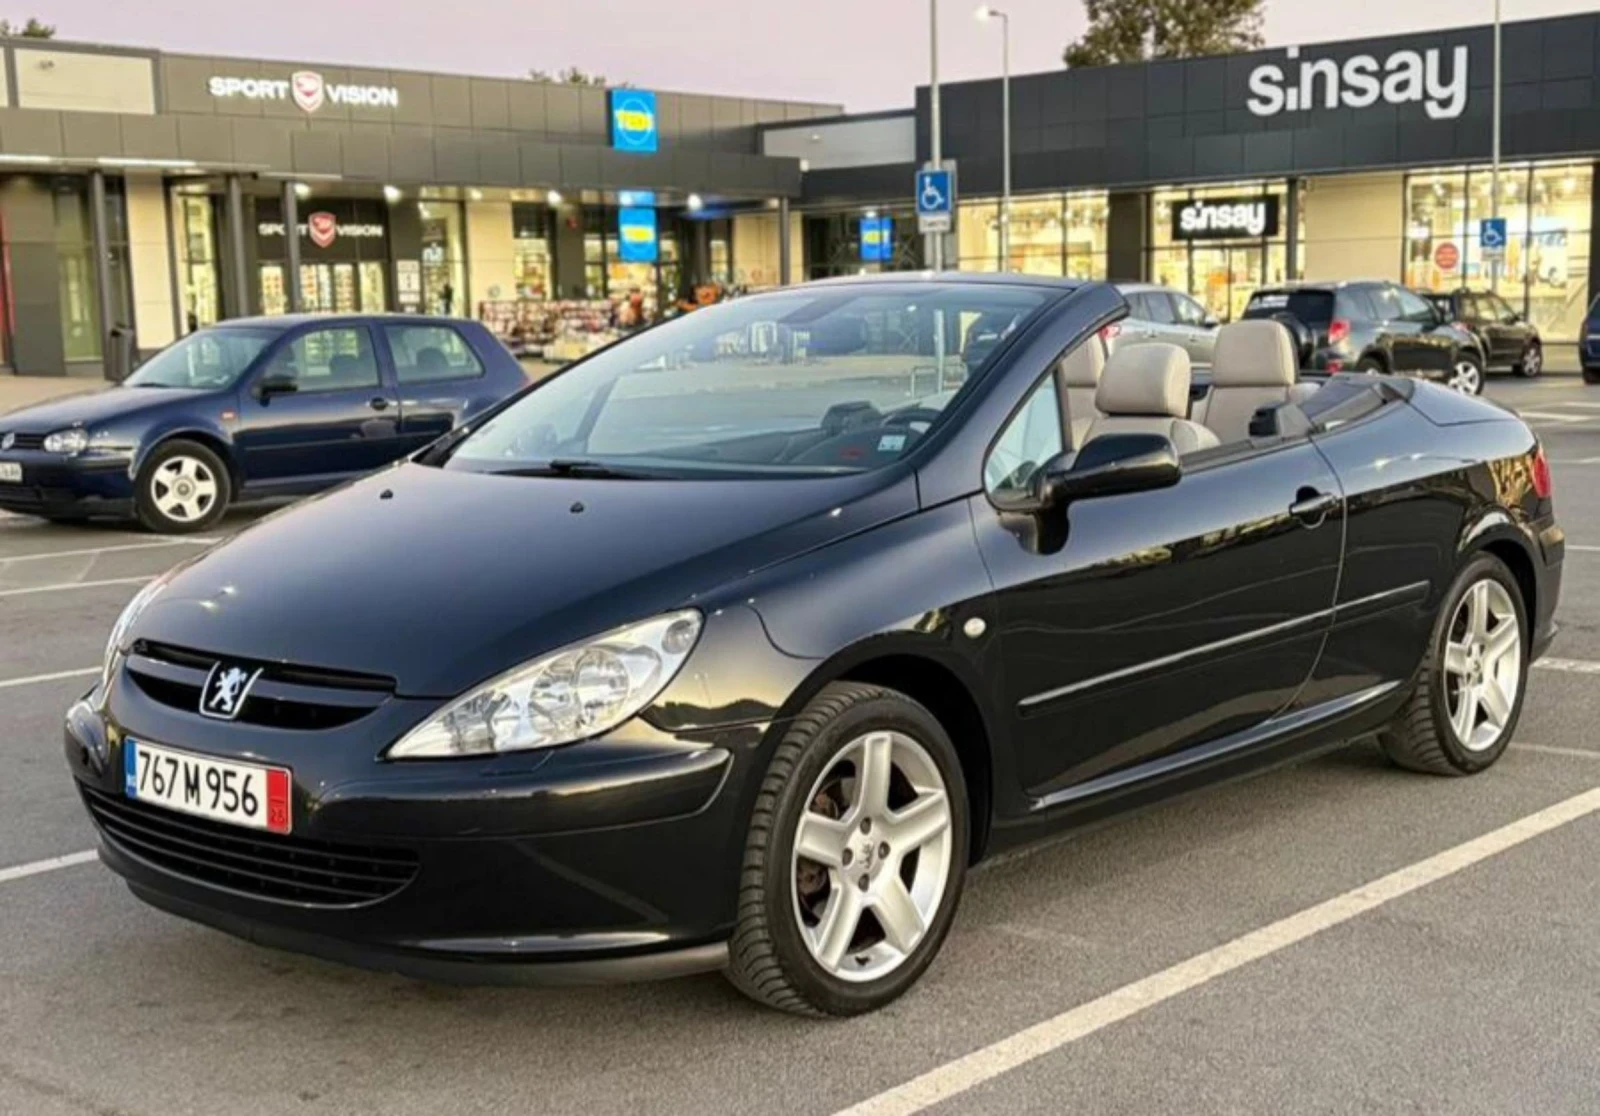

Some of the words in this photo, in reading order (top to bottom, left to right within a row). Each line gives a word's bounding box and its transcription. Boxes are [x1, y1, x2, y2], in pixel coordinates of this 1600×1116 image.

[208, 76, 289, 99] SPORT
[326, 84, 398, 107] VISION
[1247, 45, 1468, 120] sinsay
[336, 224, 384, 237] VISION
[1180, 200, 1266, 235] sinsay
[139, 751, 179, 798] 767
[184, 761, 200, 806] M
[205, 767, 258, 817] 956
